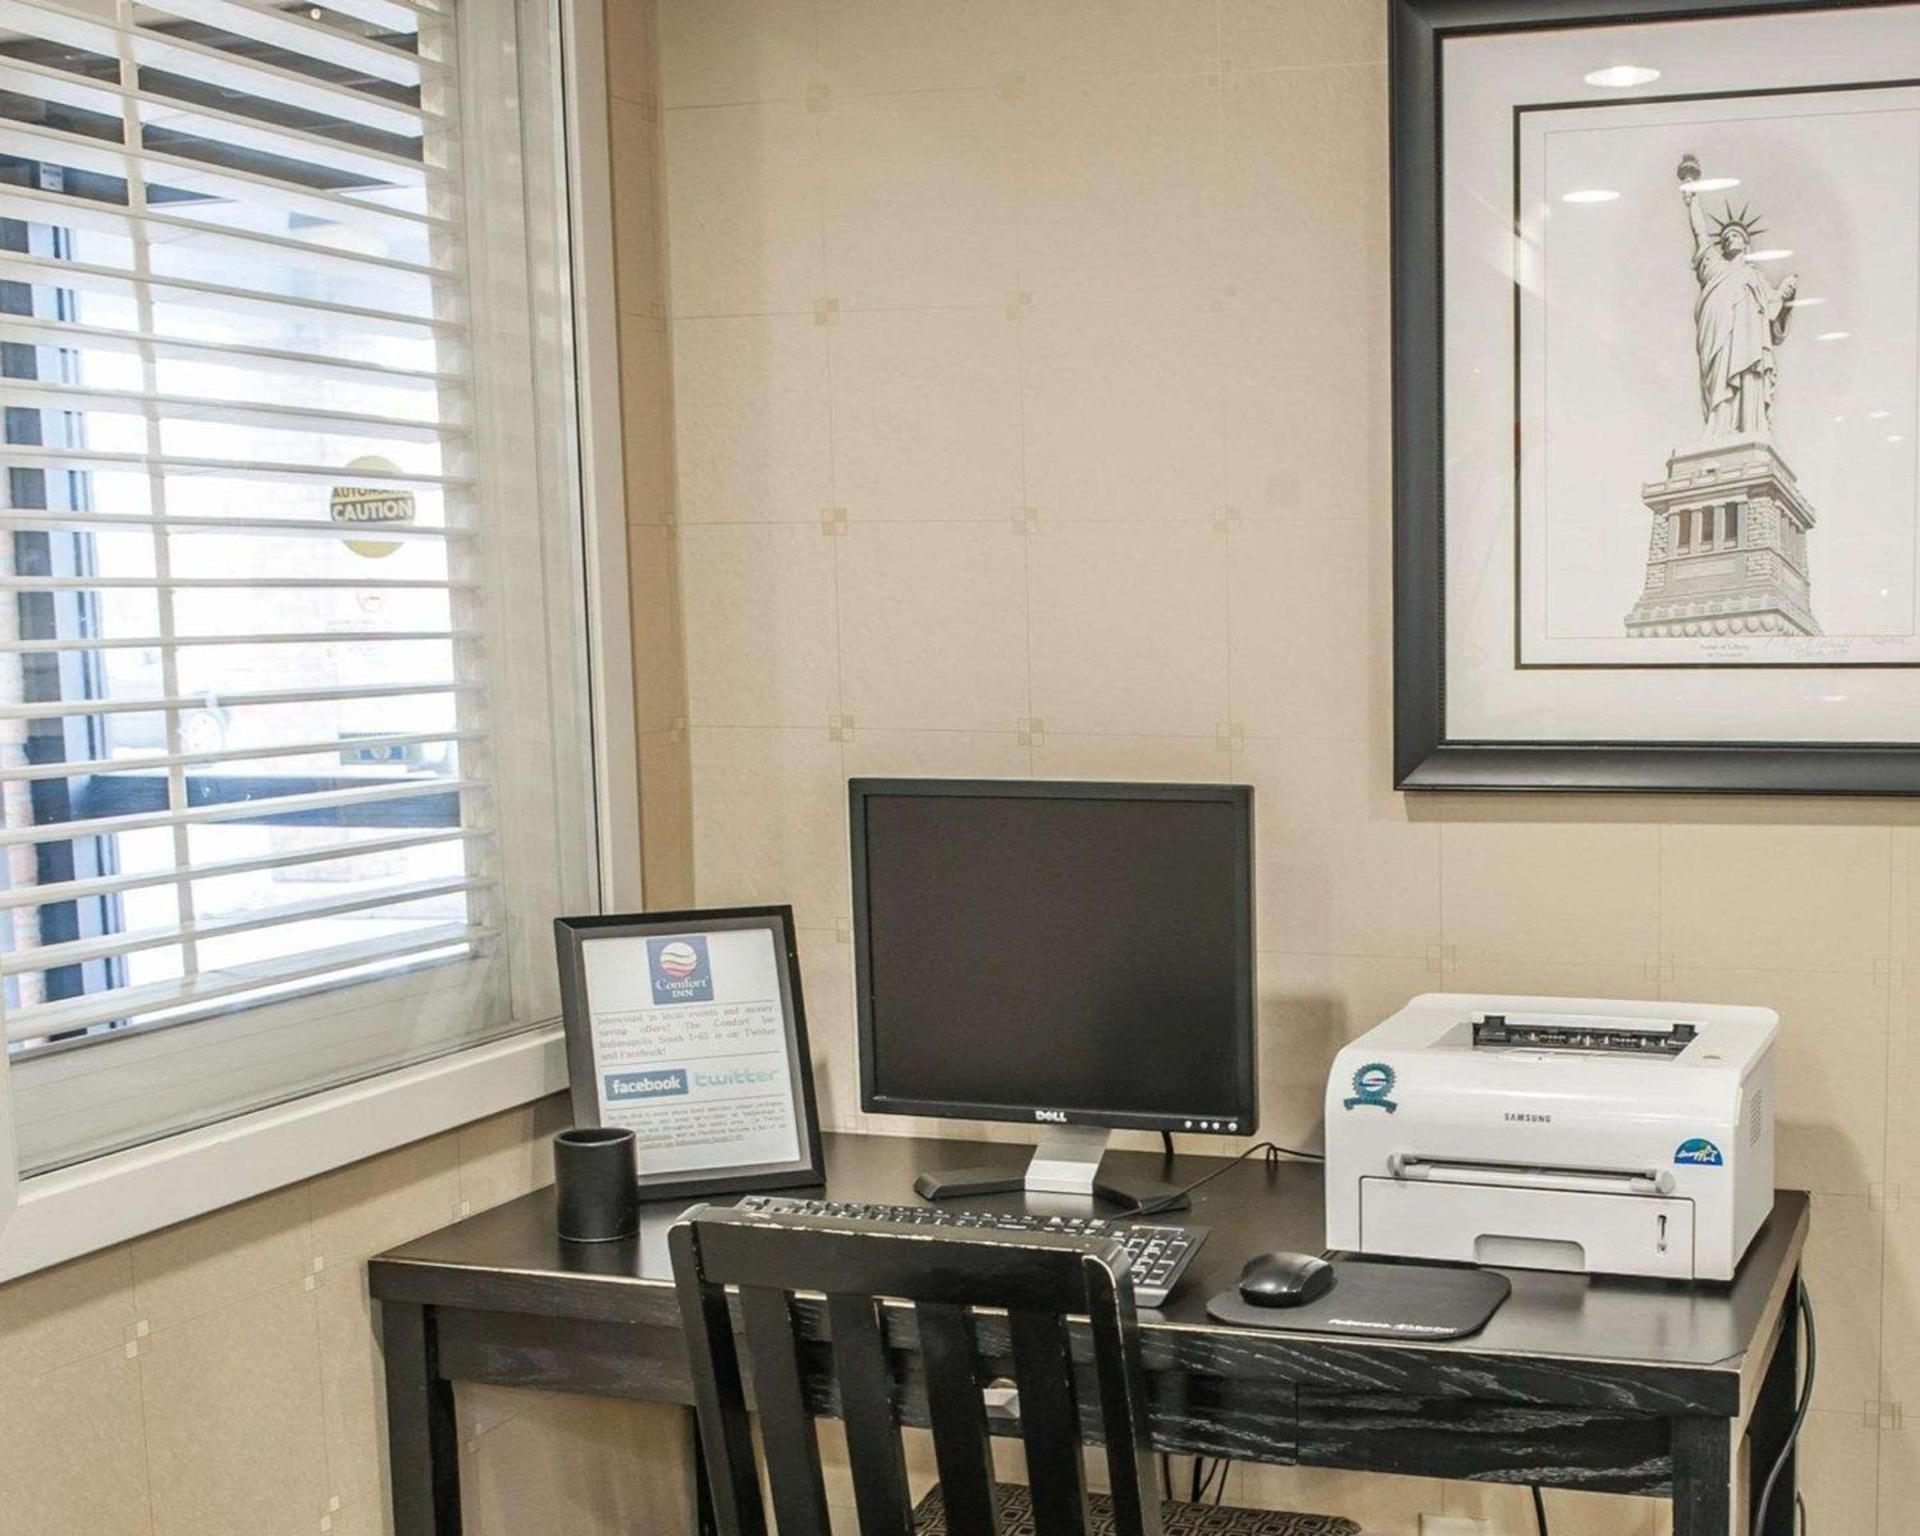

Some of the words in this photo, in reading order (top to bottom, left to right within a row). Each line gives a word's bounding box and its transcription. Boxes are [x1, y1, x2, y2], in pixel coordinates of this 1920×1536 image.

[333, 500, 413, 520] CAUTION
[655, 976, 707, 991] Comfort
[671, 989, 694, 998] INN
[612, 1076, 681, 1094] facebook
[694, 1069, 779, 1087] twitter
[1035, 1110, 1067, 1122] DELL
[1504, 1112, 1551, 1123] SAMSUNG
